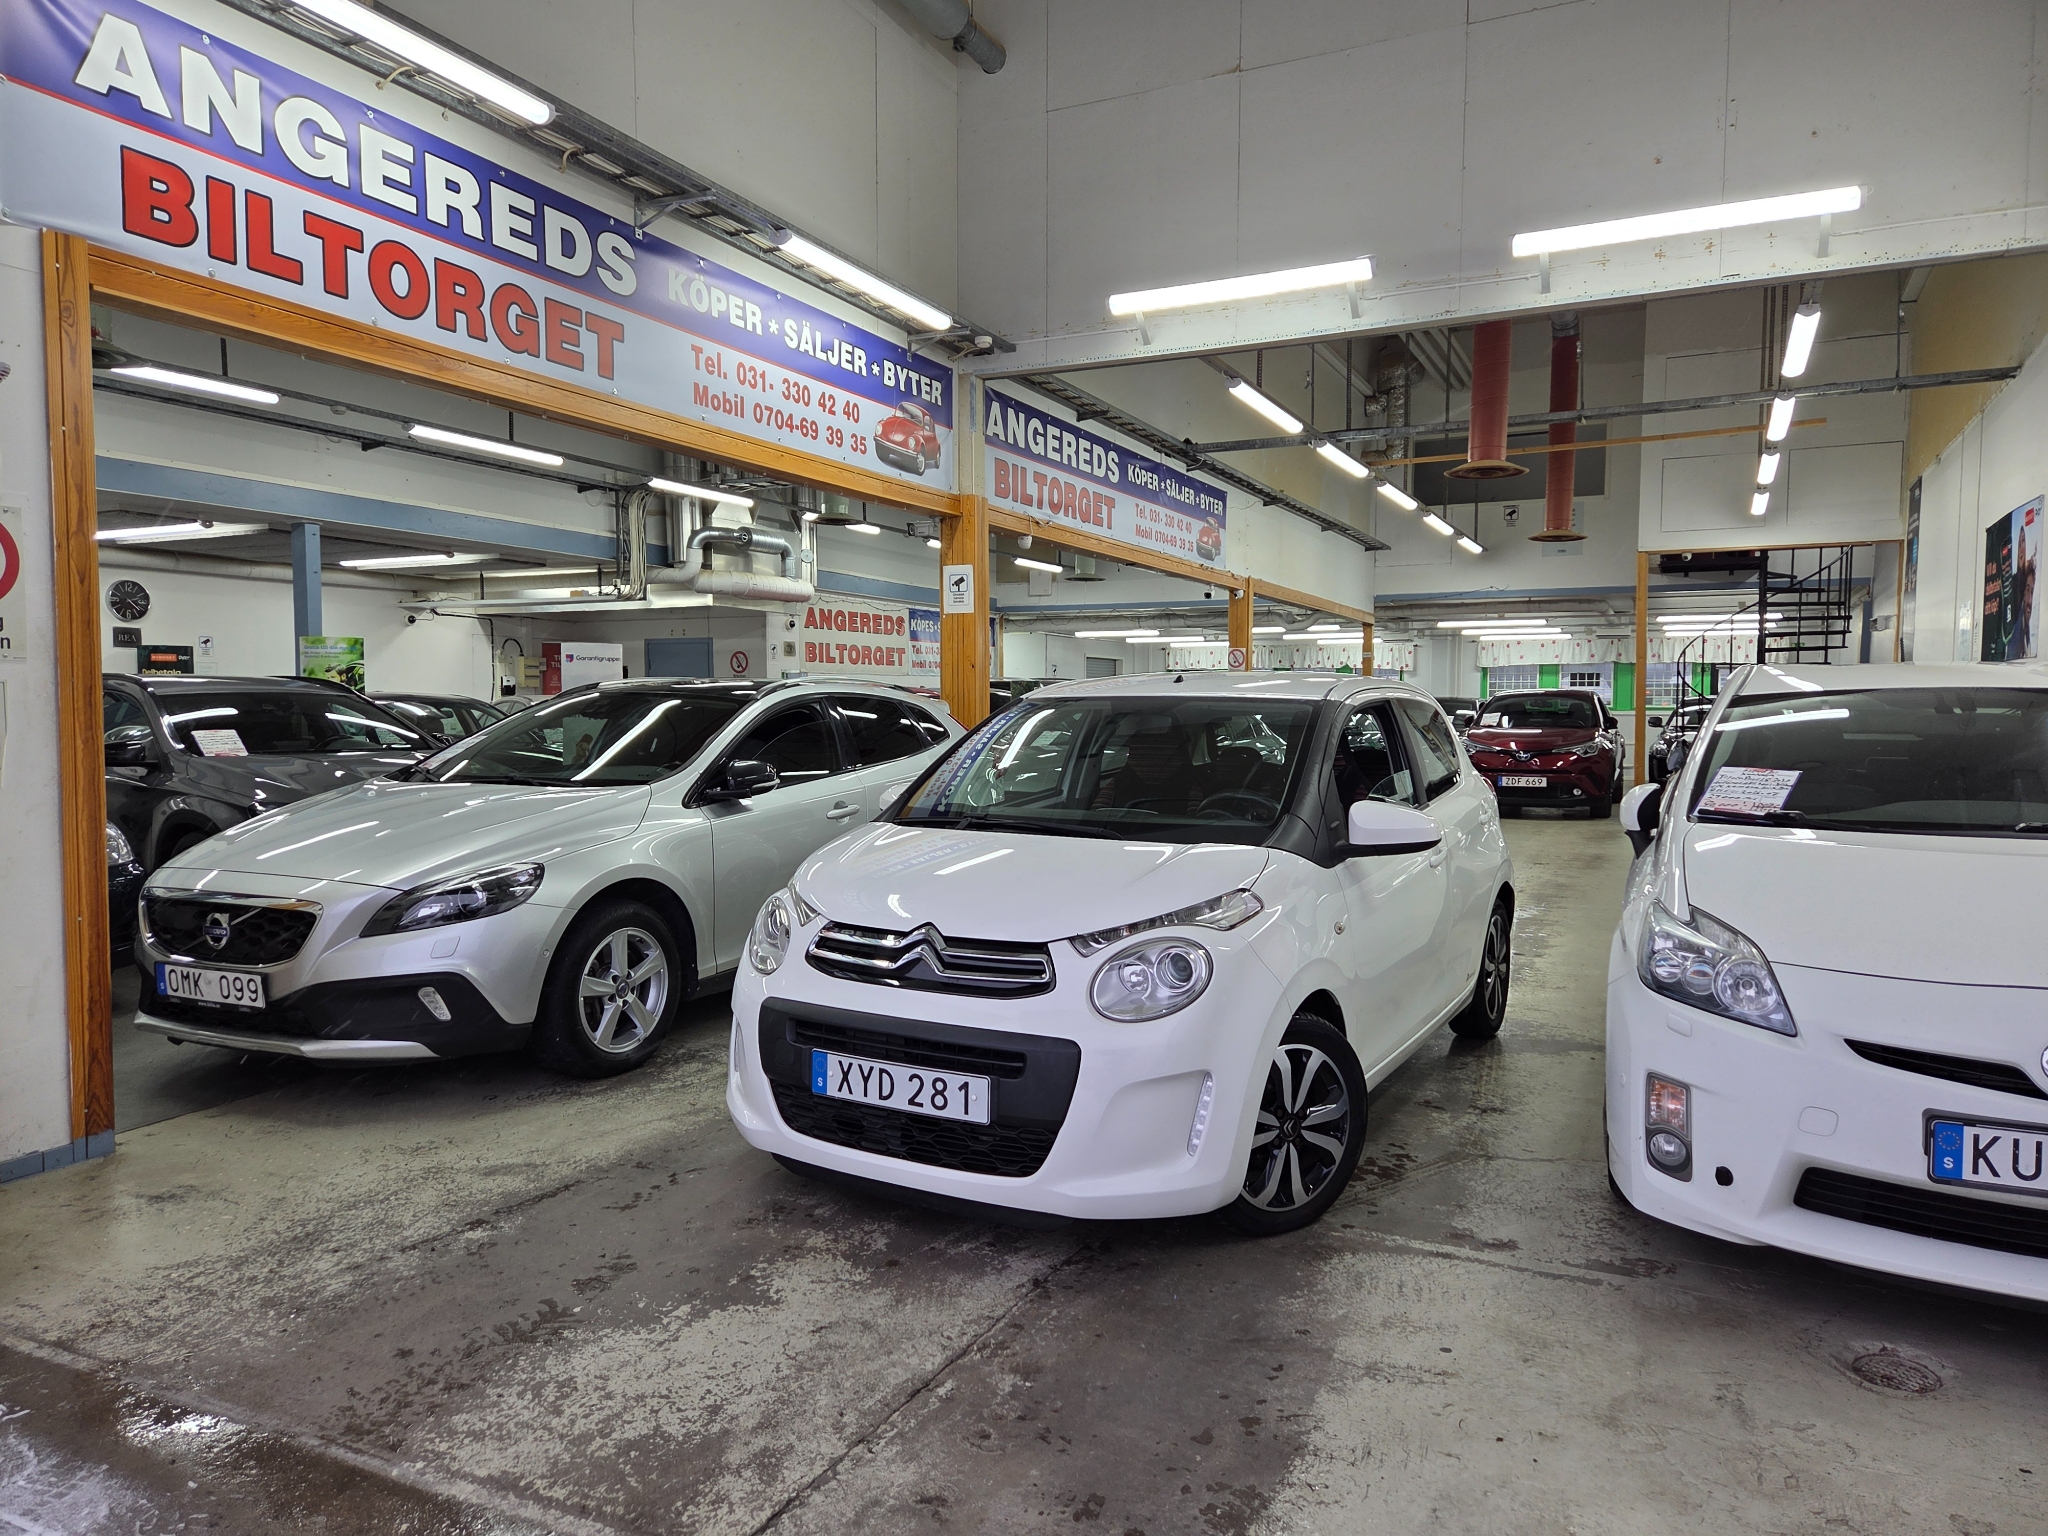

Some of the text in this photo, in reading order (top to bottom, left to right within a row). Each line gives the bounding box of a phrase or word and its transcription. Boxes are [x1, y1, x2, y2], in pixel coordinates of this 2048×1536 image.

[75, 12, 638, 297] ANGEREDS
[120, 145, 625, 380] BILTORGET
[668, 269, 943, 406] KÖPER SÄLJER BYTER
[691, 344, 860, 424] Tel. 031- 330 42 40
[693, 382, 867, 455] Mobil 0704-69 39 35
[986, 400, 1120, 484] ANGEREDS
[994, 457, 1116, 530] BILTORGET
[1127, 463, 1224, 516] KÖPER SÄLJER BYTER
[1135, 503, 1147, 519] Tel.
[1165, 513, 1175, 528] 330
[1177, 518, 1184, 532] 42
[1185, 521, 1192, 534] 40
[1135, 523, 1194, 552] Mobil 0704-69 39 35
[125, 582, 133, 592] 12
[126, 609, 132, 619] 6
[804, 606, 906, 636] ANGEREDS
[118, 633, 136, 642] REA
[805, 641, 906, 667] BILTORGET
[912, 645, 923, 654] Tel.
[912, 660, 926, 668] Mobil
[1525, 778, 1543, 786] 669
[168, 969, 204, 998] OMK
[219, 974, 259, 1003] 099
[817, 1060, 970, 1116] S XYD 281
[1943, 1133, 2043, 1181] S KU
